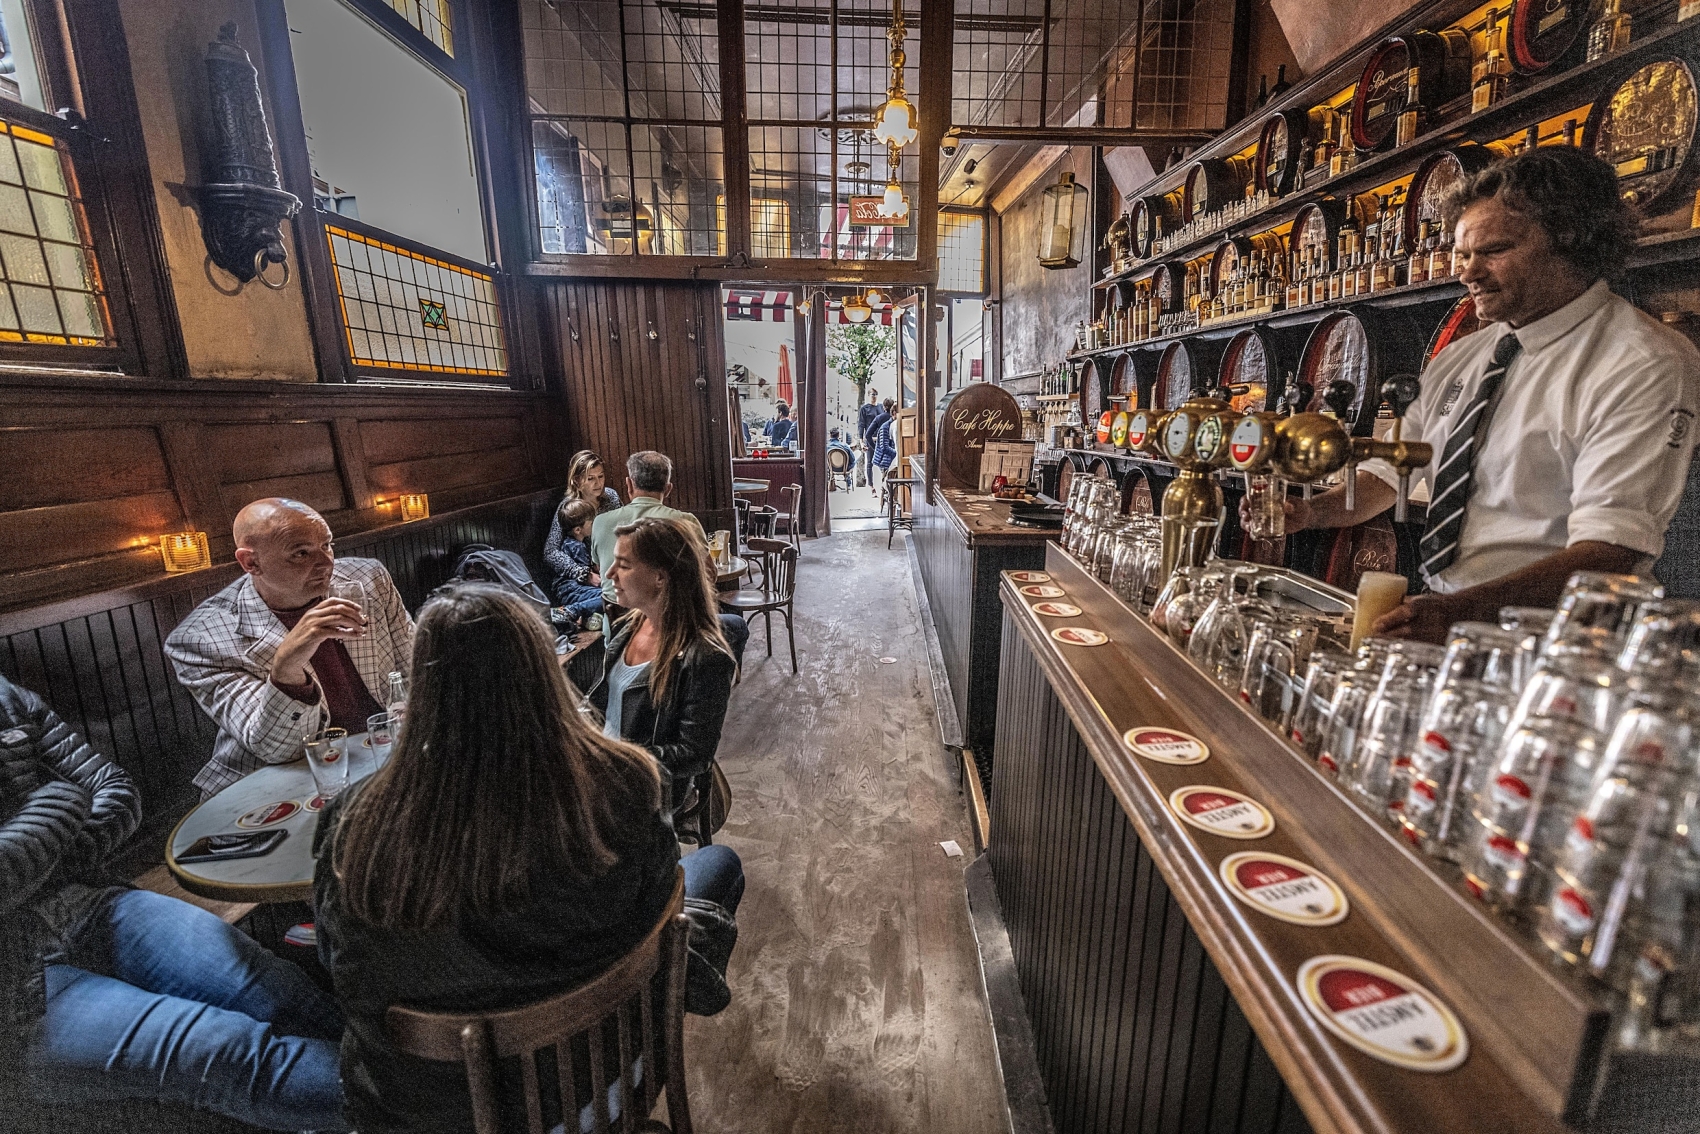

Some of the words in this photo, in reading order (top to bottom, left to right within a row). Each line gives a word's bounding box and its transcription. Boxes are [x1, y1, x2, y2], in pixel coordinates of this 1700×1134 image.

[952, 409, 980, 436] Café
[979, 409, 1015, 437] Hoppe
[1146, 743, 1194, 752] AMSTEL
[1201, 804, 1252, 822] AMSTEL
[1257, 881, 1319, 902] AMSTEL
[1347, 1003, 1425, 1033] AMSTEL
